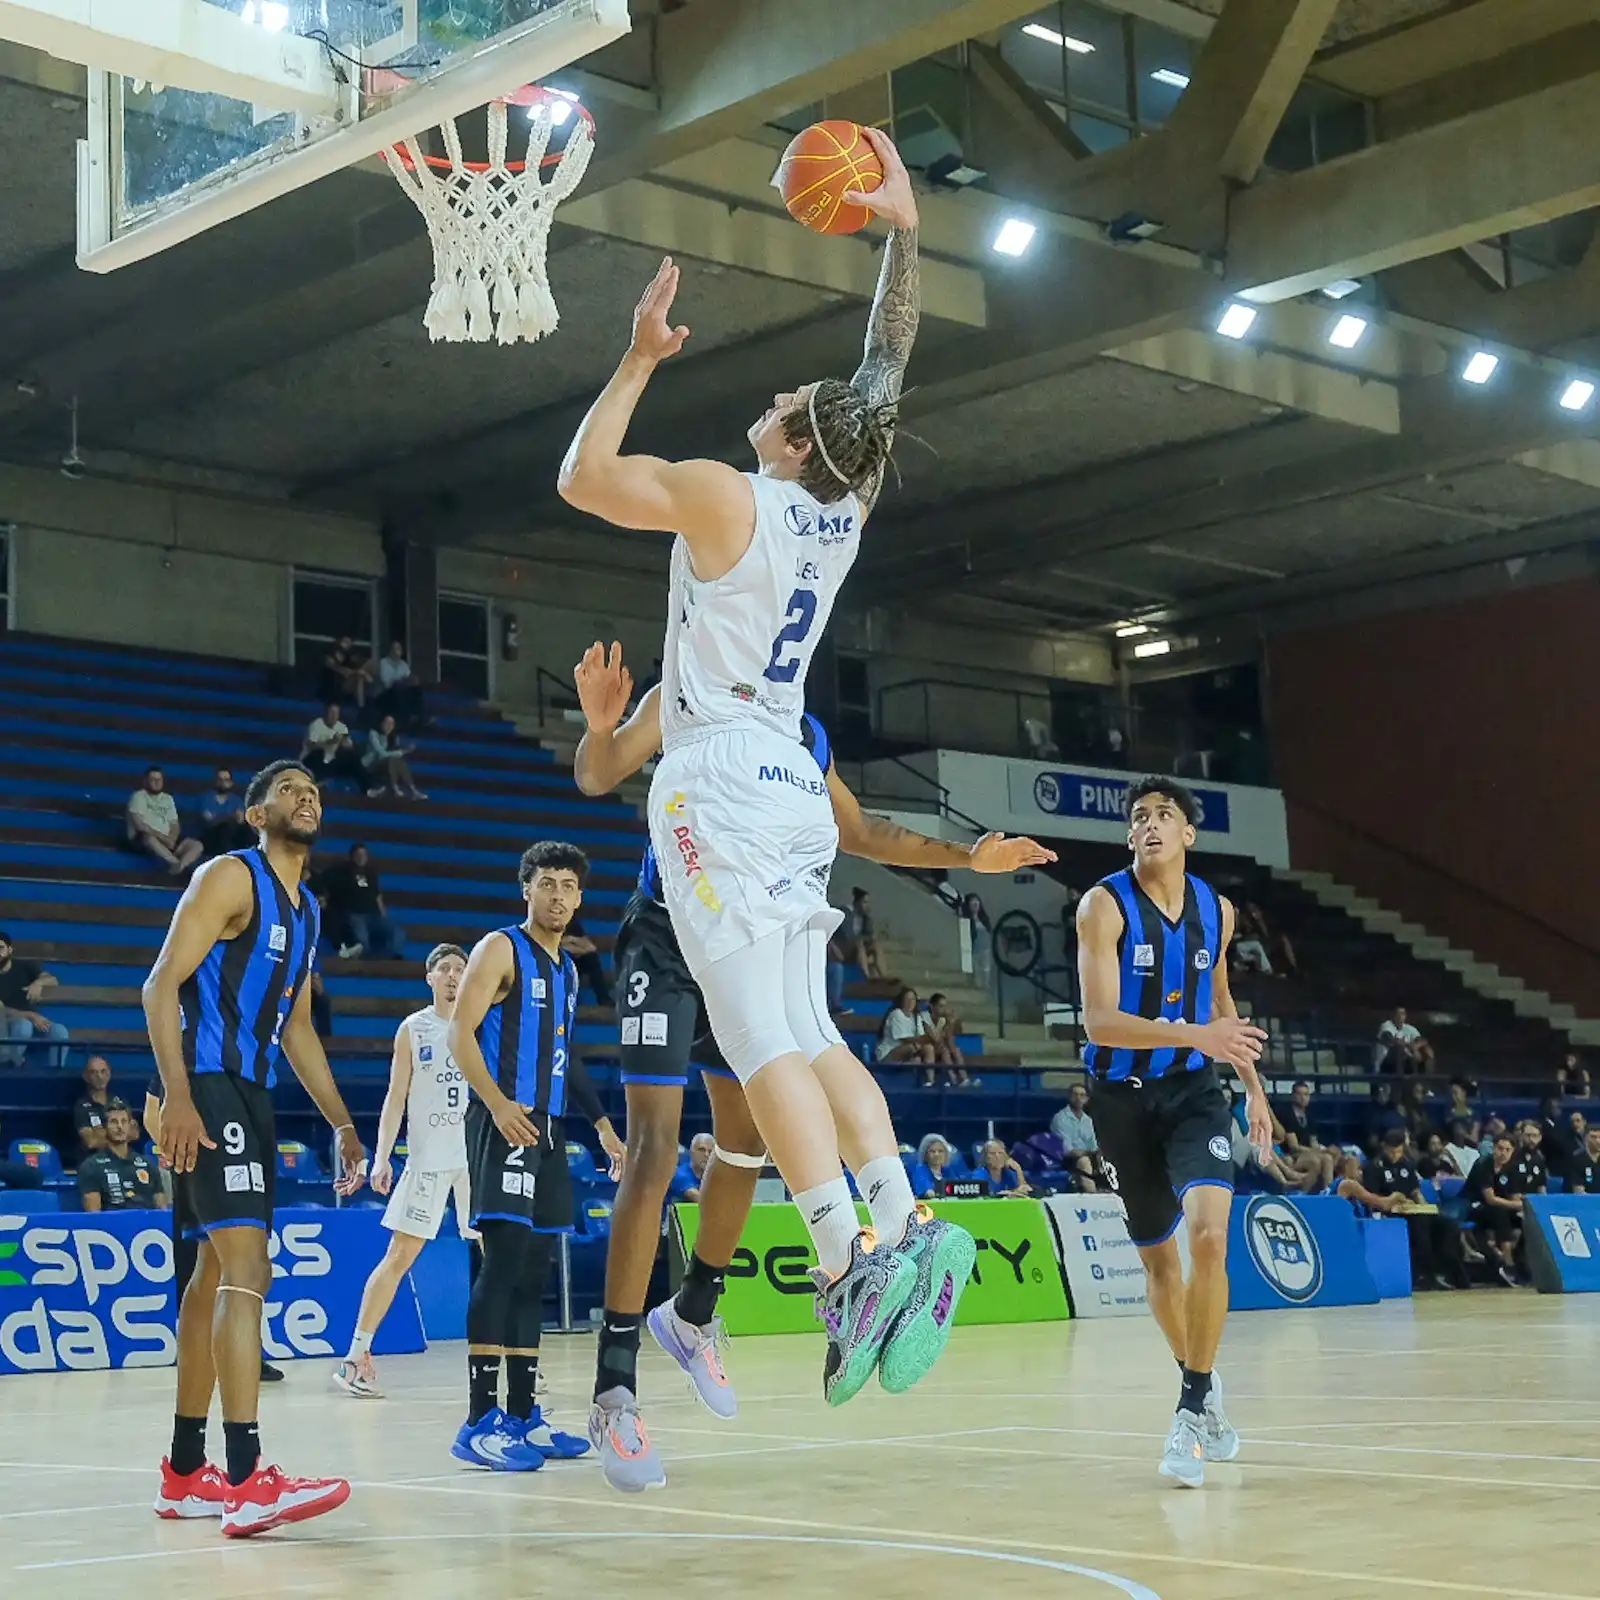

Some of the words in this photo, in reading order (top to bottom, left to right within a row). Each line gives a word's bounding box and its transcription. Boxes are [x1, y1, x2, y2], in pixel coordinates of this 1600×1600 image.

[762, 588, 817, 682] 2
[627, 970, 650, 1008] 3
[552, 1048, 566, 1076] 2
[447, 1086, 459, 1108] 9
[223, 1121, 246, 1155] 9
[0, 1215, 332, 1306] Espos
[0, 1294, 335, 1370] daSte
